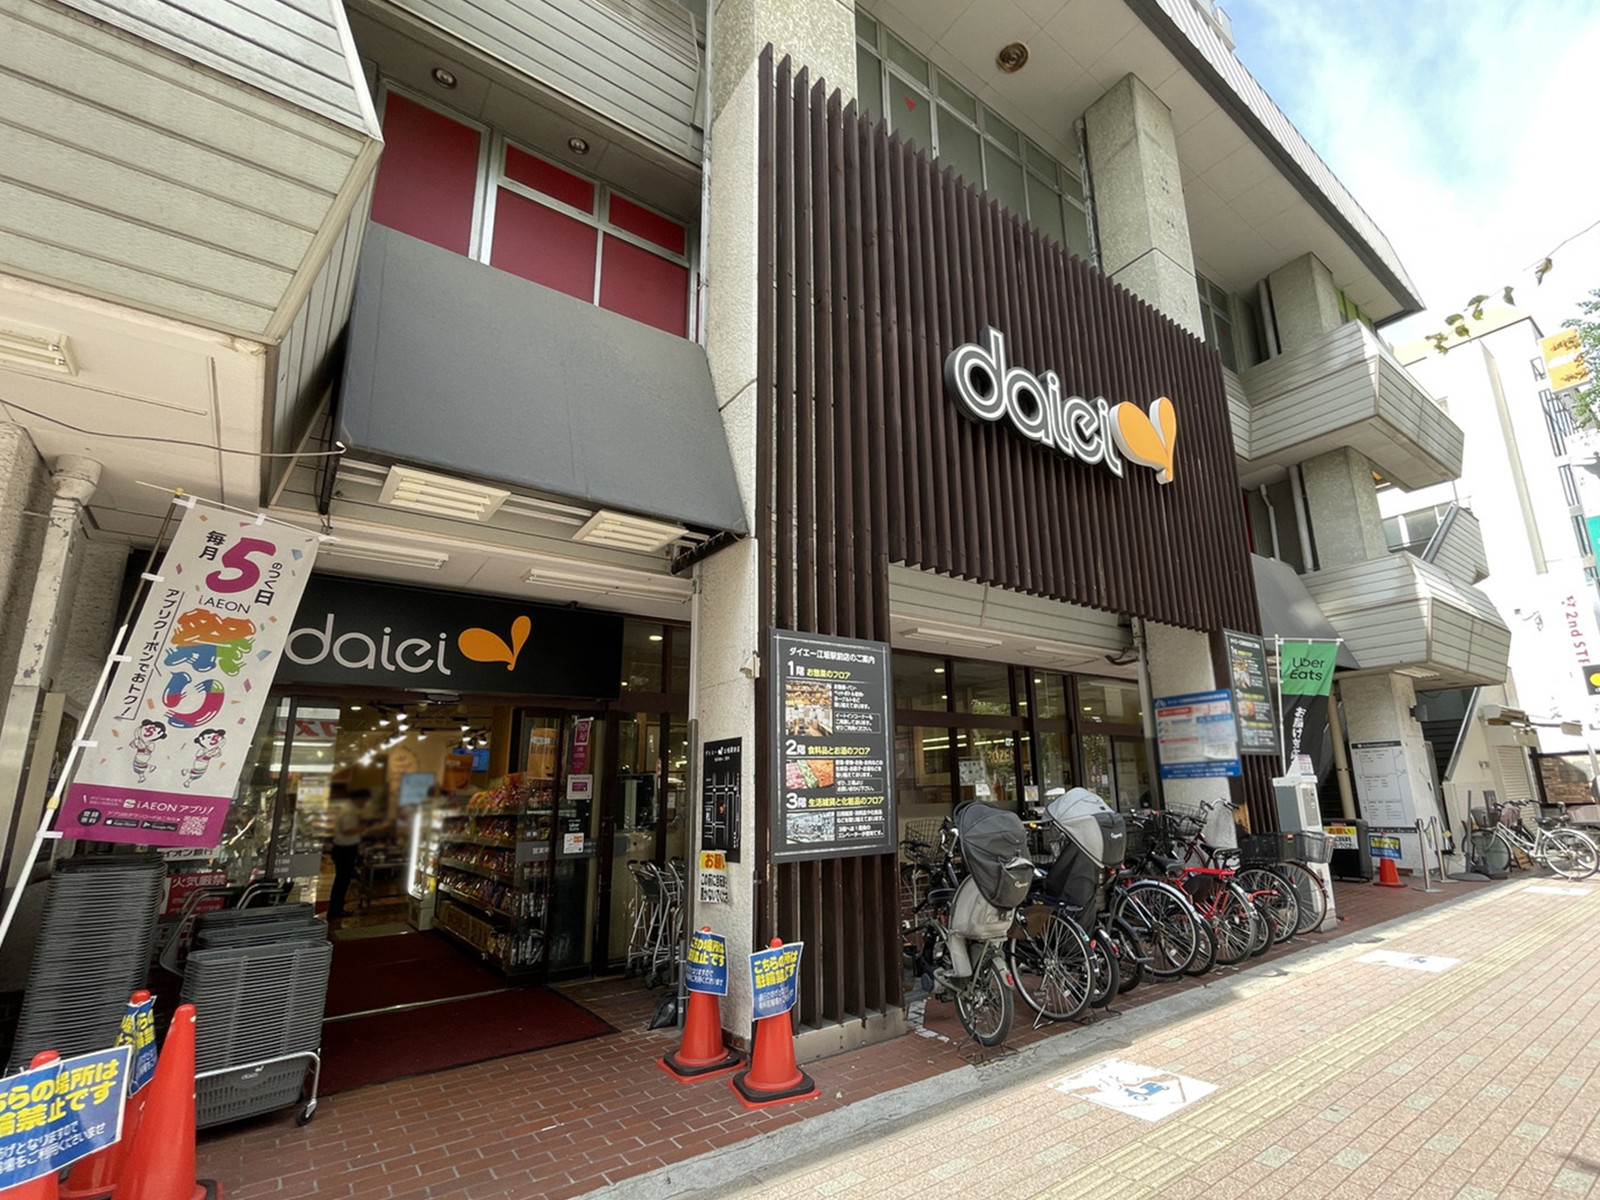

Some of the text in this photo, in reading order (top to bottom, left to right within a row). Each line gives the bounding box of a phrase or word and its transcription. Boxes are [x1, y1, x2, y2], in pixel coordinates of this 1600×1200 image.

[945, 326, 1123, 478] daiei
[199, 530, 227, 561] 毎月
[205, 537, 276, 594] 5
[254, 562, 283, 606] のつく日
[198, 595, 251, 615] iAEON
[284, 613, 451, 675] daiei
[1289, 669, 1324, 682] Eats
[1292, 657, 1326, 669] Uber
